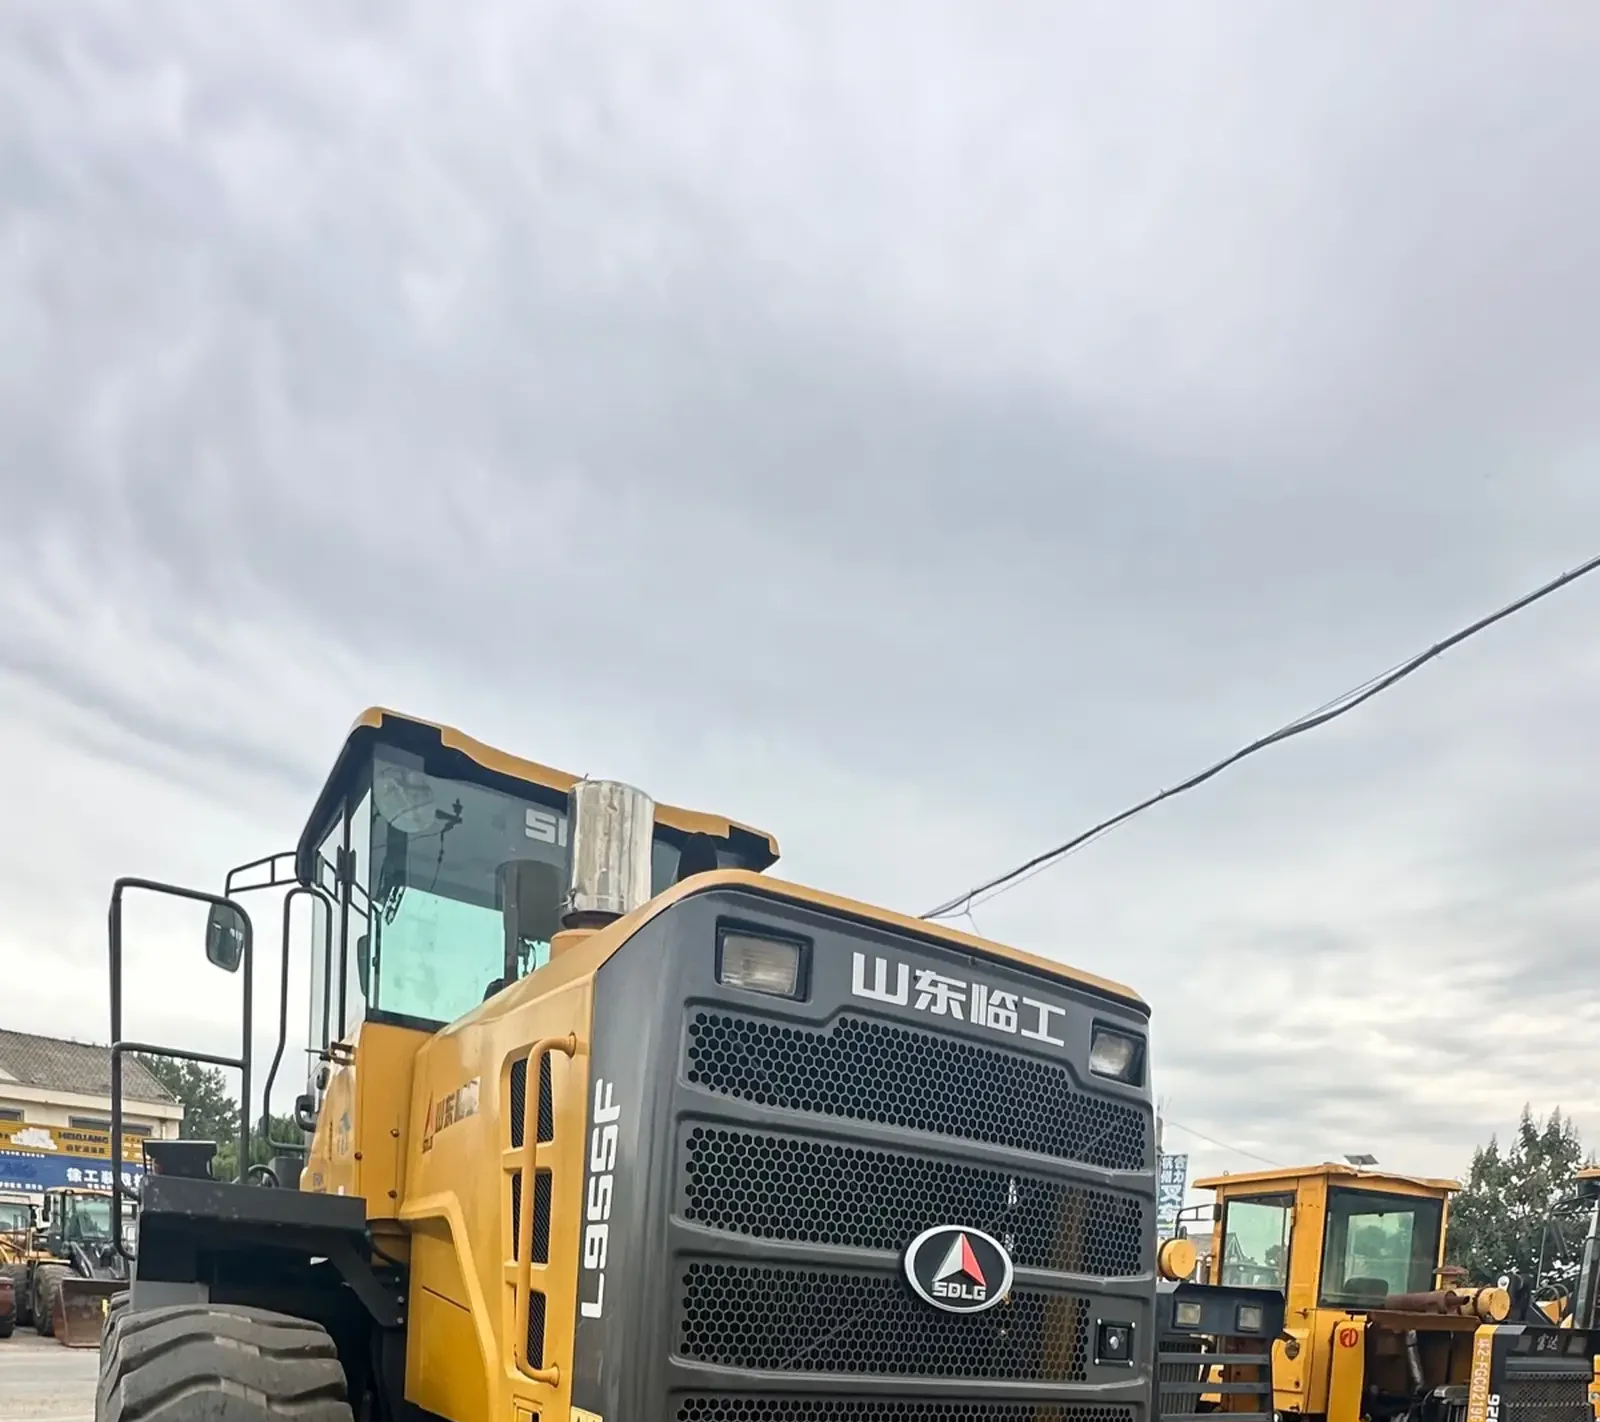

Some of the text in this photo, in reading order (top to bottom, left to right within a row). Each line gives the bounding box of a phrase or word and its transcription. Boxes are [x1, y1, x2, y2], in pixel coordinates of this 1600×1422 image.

[852, 952, 1066, 1047] 山东临工
[581, 1078, 621, 1319] L955F
[931, 1281, 987, 1301] SDLG
